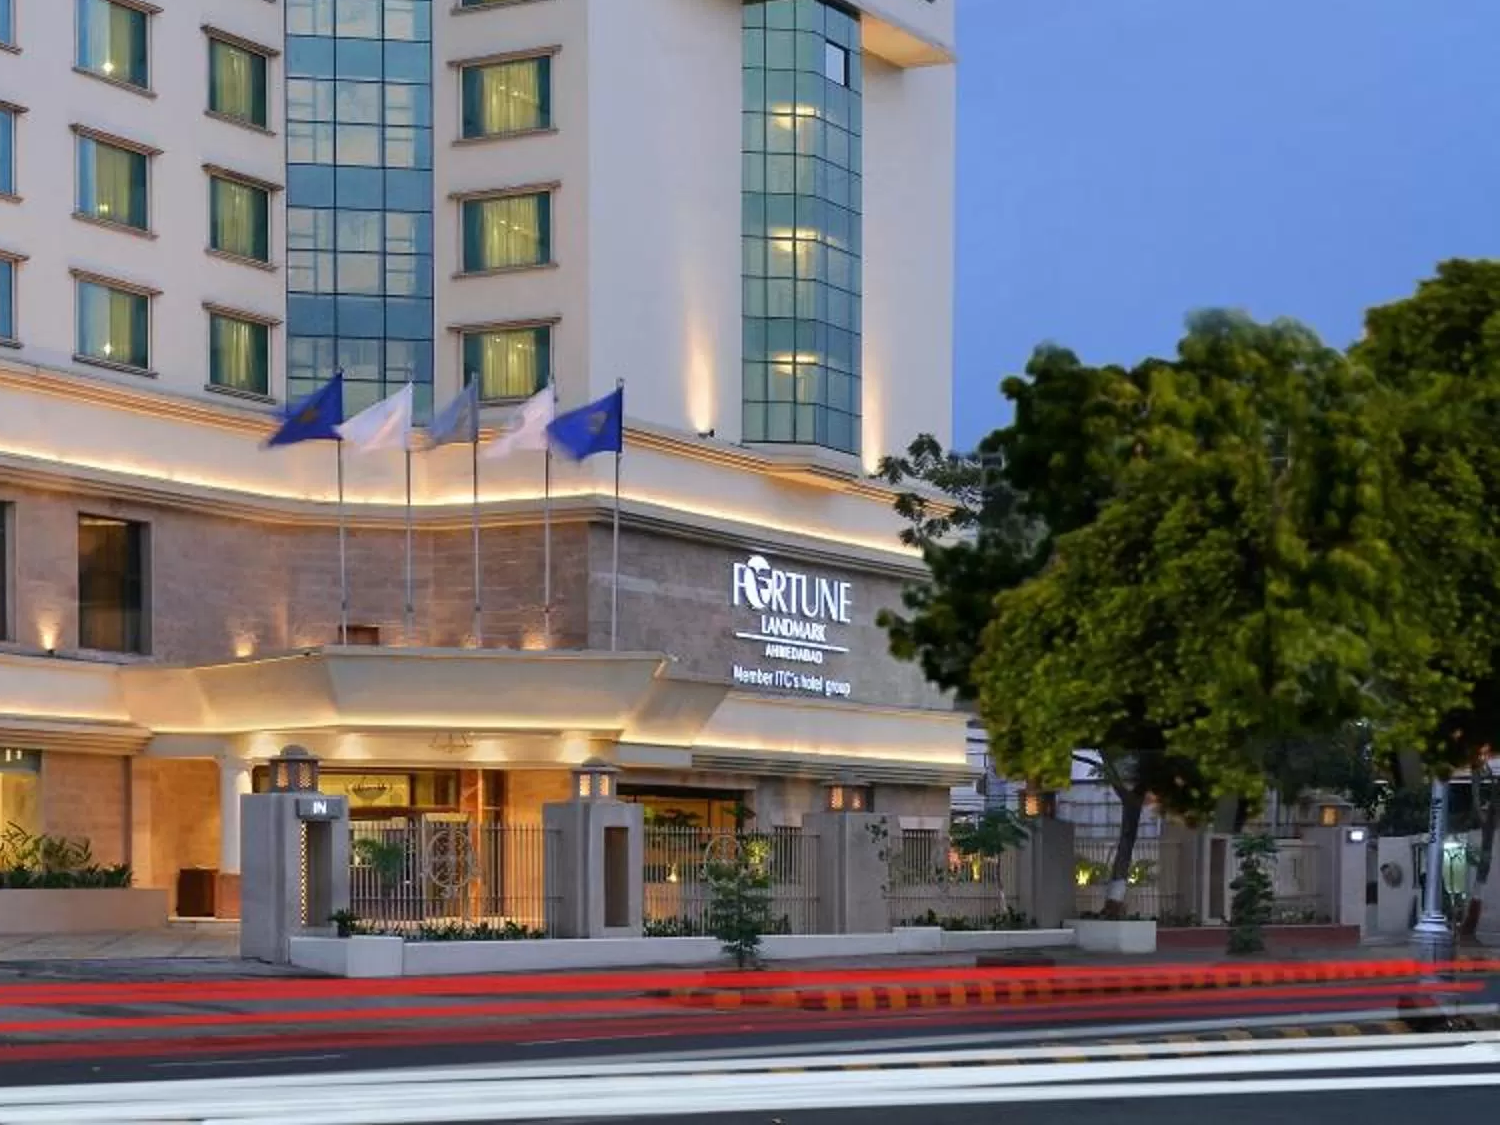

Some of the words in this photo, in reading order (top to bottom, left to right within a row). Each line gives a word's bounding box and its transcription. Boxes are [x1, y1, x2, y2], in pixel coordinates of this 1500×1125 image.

[733, 555, 852, 623] FORTUNE
[761, 614, 827, 642] LANDMARK
[733, 665, 774, 686] Member
[775, 670, 799, 689] ITC's
[800, 674, 823, 692] hotel
[825, 679, 851, 698] group
[312, 801, 327, 814] IN
